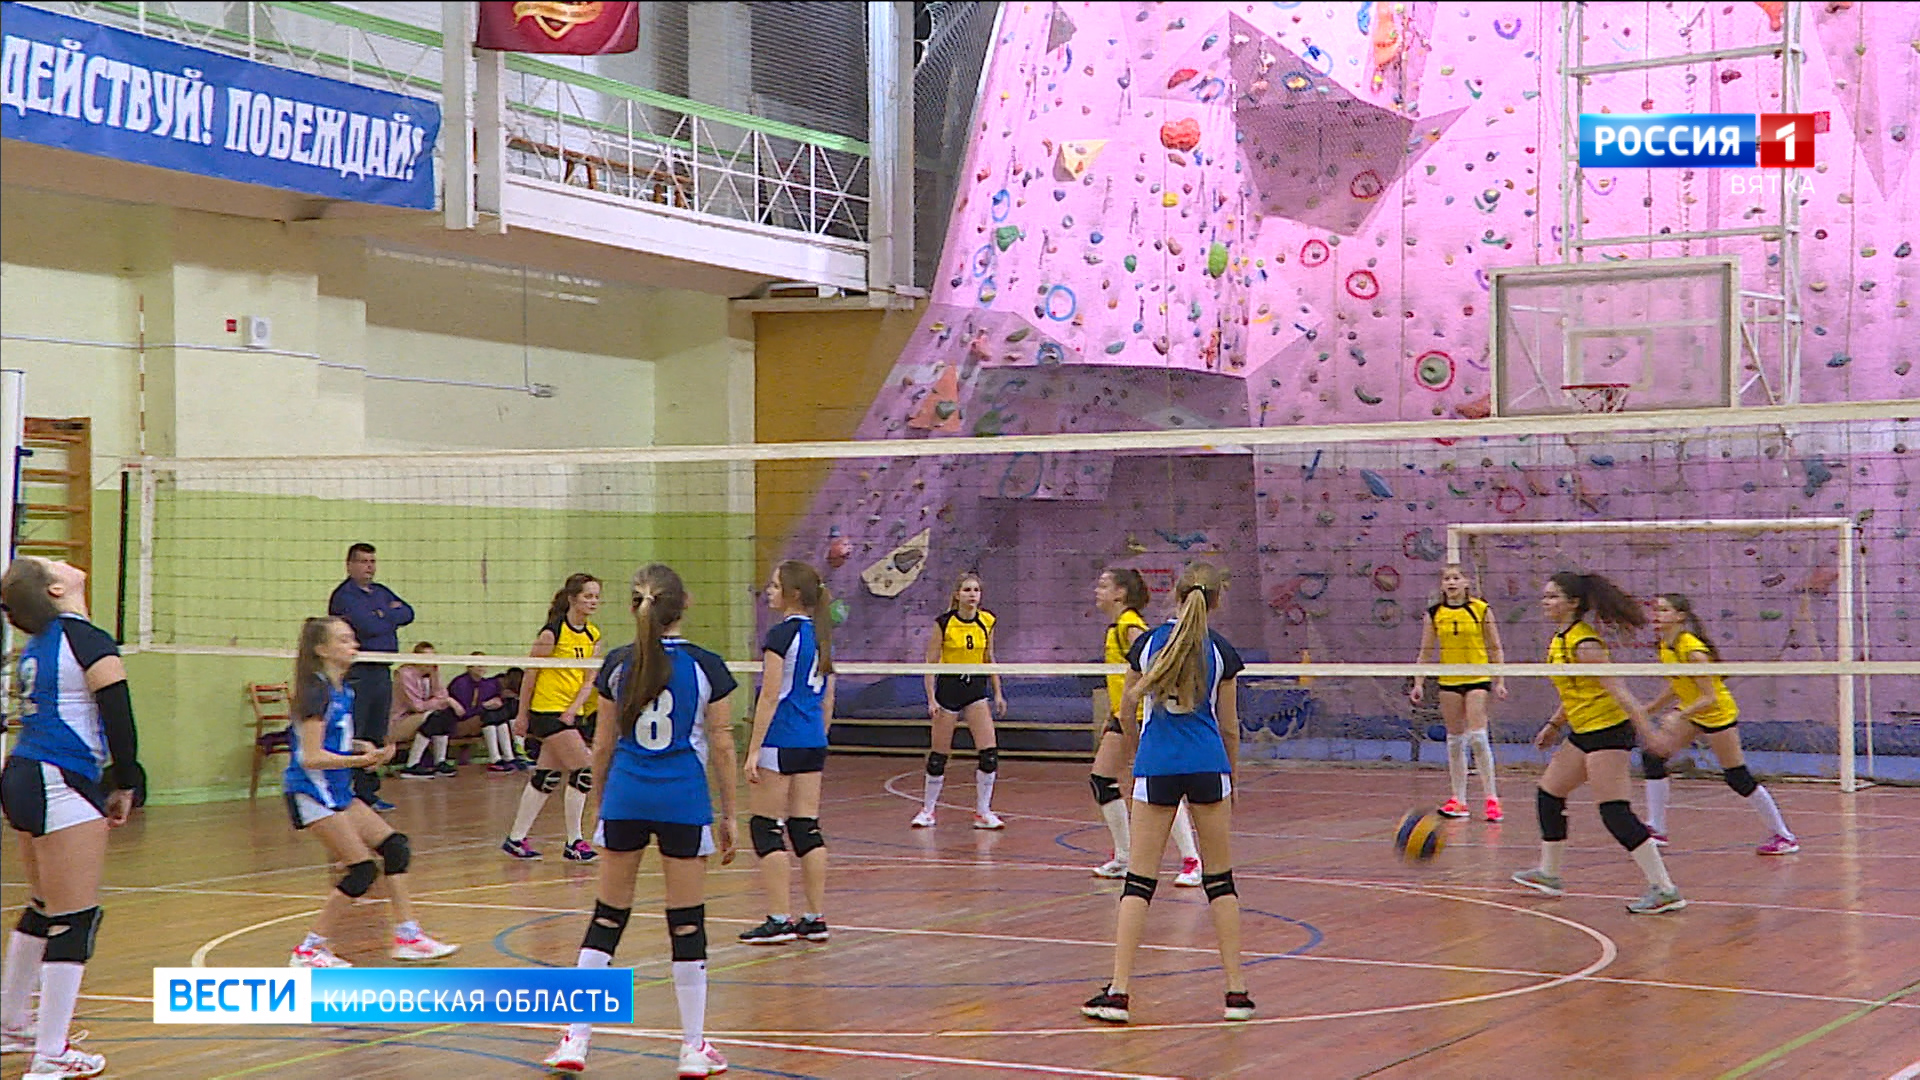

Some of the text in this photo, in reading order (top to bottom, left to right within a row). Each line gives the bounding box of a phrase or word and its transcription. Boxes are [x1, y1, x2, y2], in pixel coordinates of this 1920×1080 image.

[1, 35, 426, 181] ДЕЙСТВУЙ! ПОБЕЖДАЙ!
[966, 635, 974, 650] 8
[635, 688, 674, 750] 8
